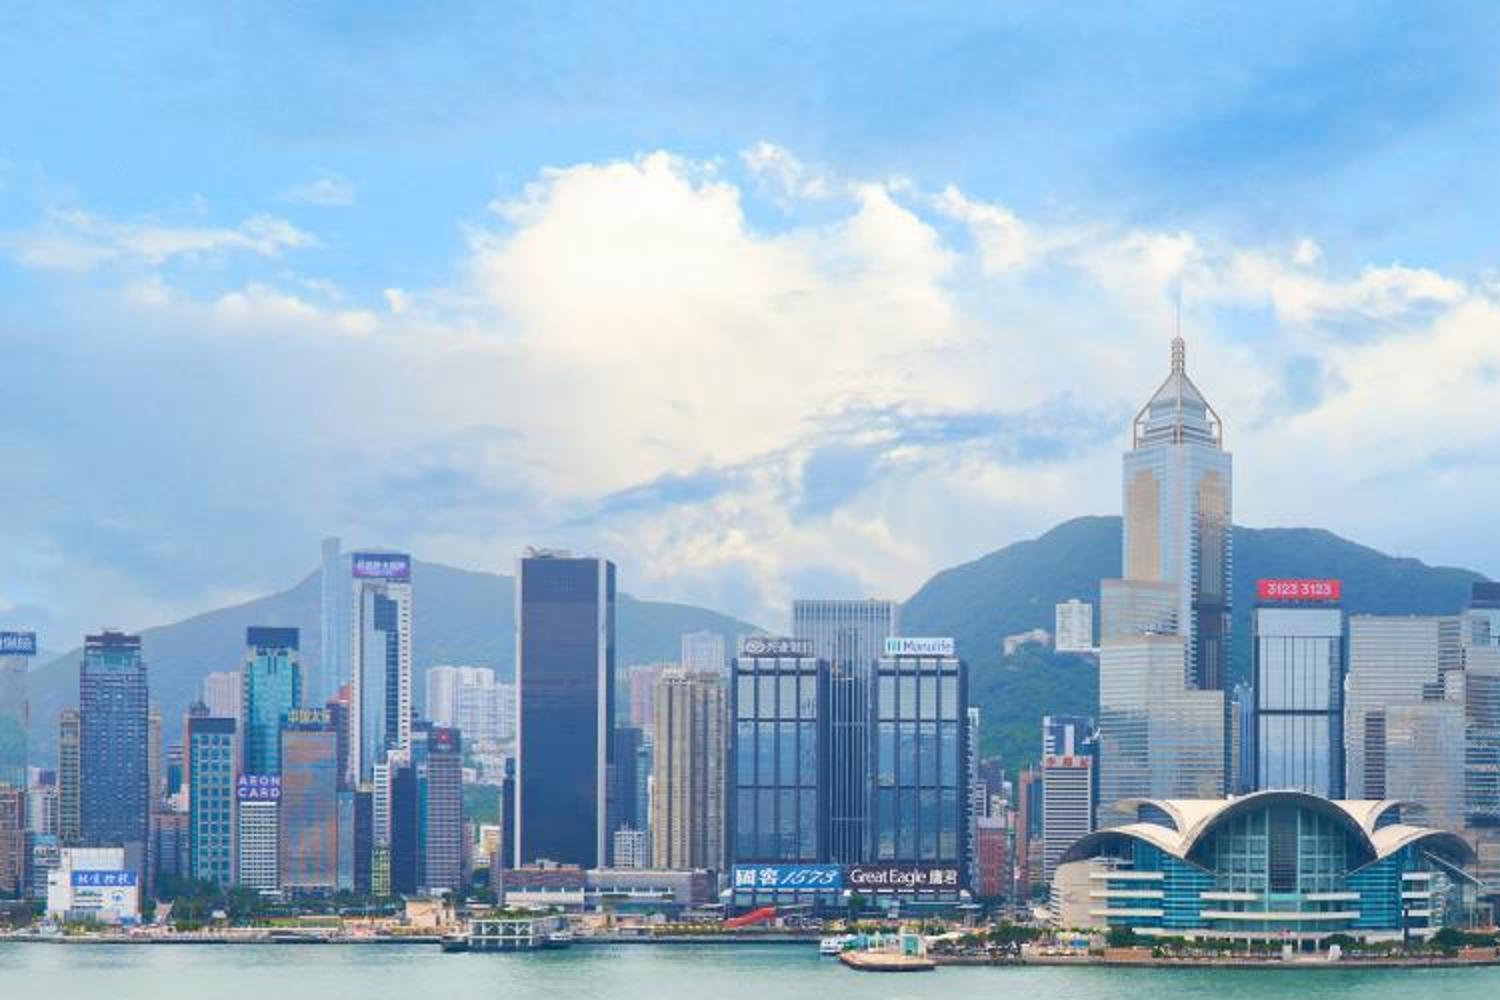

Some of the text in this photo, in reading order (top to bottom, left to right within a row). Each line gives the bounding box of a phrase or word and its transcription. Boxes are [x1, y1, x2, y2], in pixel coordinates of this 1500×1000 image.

[239, 775, 281, 787] AEON
[238, 787, 281, 798] CARD
[851, 868, 888, 884] Great
[889, 868, 927, 887] Eagle
